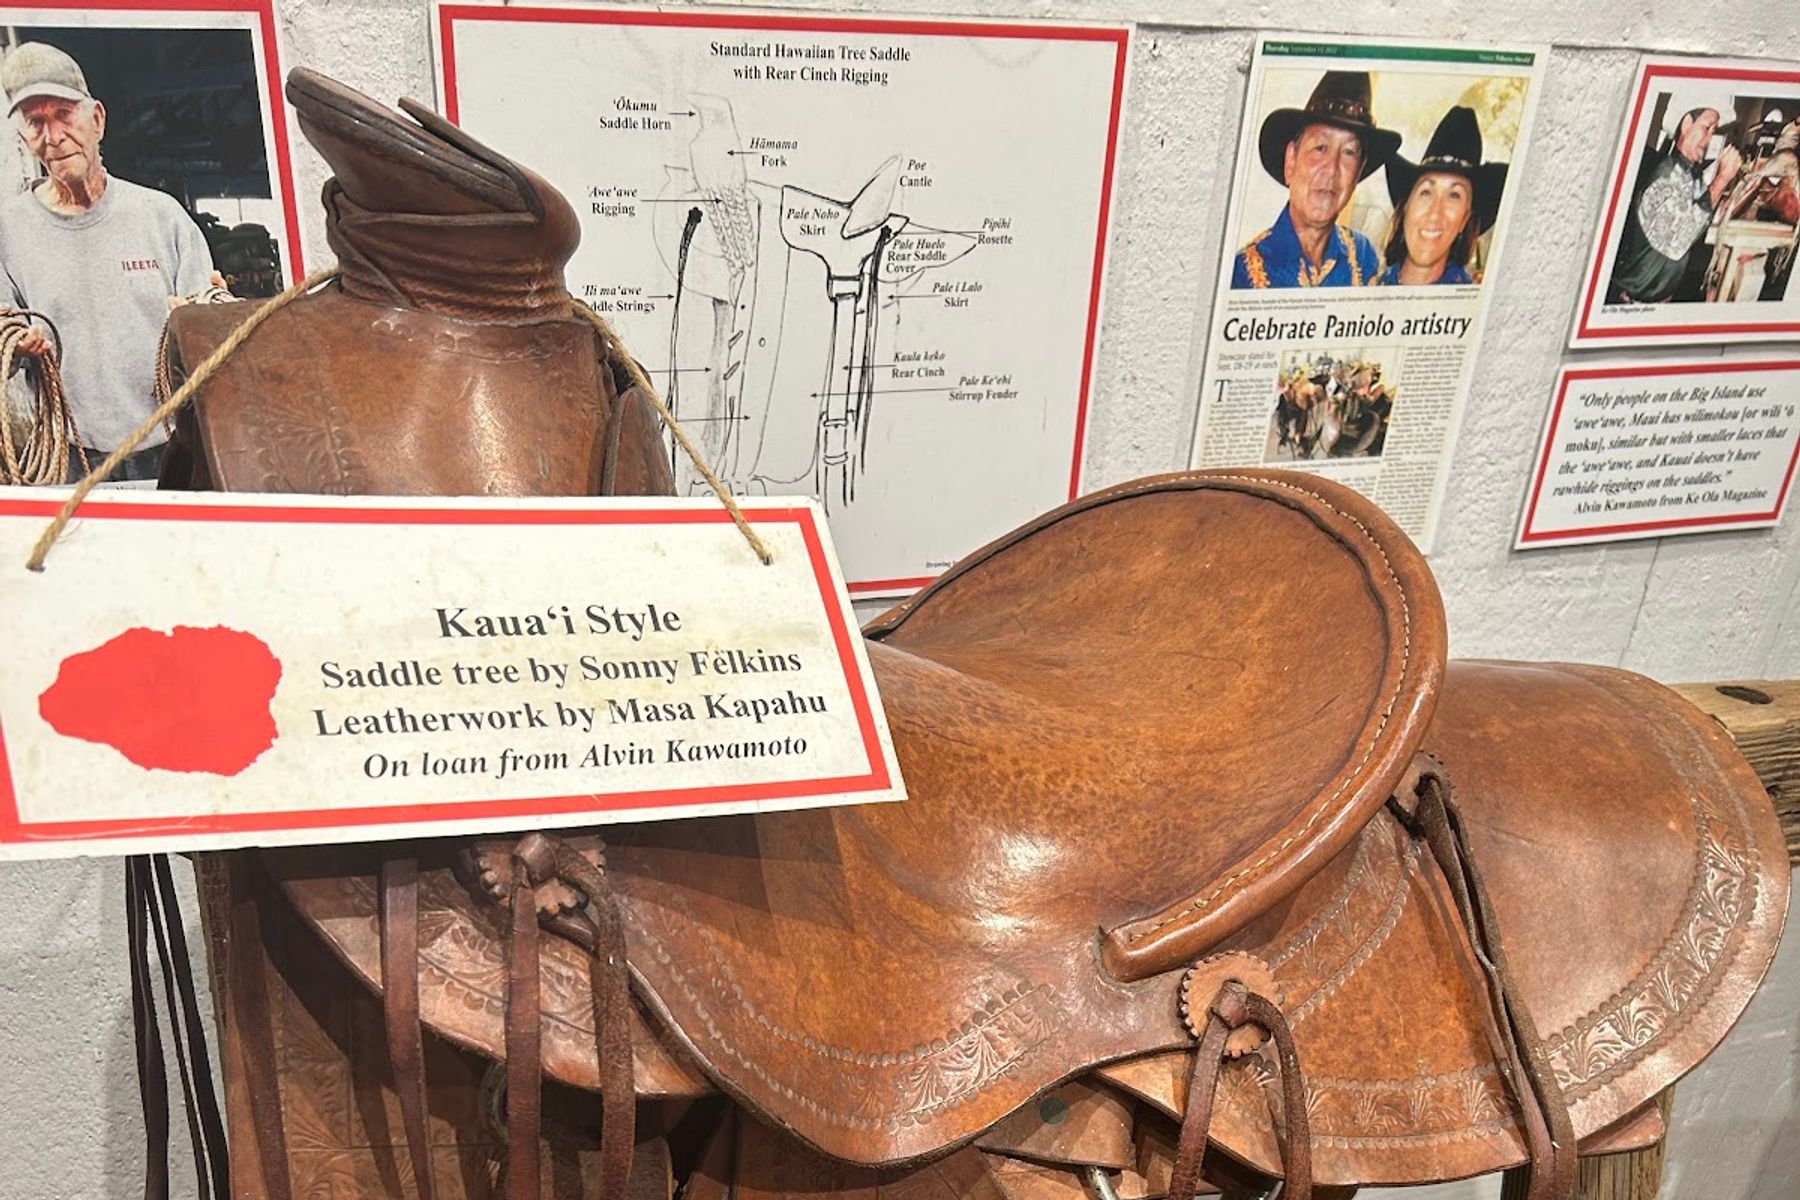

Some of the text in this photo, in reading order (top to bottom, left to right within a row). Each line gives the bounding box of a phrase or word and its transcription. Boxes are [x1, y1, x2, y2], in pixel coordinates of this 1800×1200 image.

[710, 42, 911, 61] Standard Hawaiian Tree Saddle
[733, 67, 889, 85] with Rear Cinch Rigging
[600, 116, 671, 130] Saddle Horn
[761, 155, 787, 167] Fork
[907, 160, 926, 171] Poe
[900, 175, 932, 187] Cantle
[592, 202, 635, 217] Rigging
[787, 208, 840, 219] Pale Noho
[800, 224, 825, 235] Skirt
[893, 239, 946, 250] Pale Huelo
[978, 234, 1013, 245] Rosette
[888, 250, 947, 261] Rear Saddle
[886, 262, 915, 273] Cover
[933, 282, 953, 293] Pale
[961, 282, 983, 293] Lalo
[616, 300, 655, 314] Strings
[944, 297, 969, 307] Skirt
[1223, 312, 1472, 342] Celebrate Paniolo artistry
[892, 367, 945, 378] Rear Cinch
[959, 376, 979, 386] Pale
[949, 388, 1019, 402] Stirrup Fender
[1611, 389, 1652, 410] people
[1652, 392, 1668, 404] on
[1668, 388, 1689, 402] the
[1689, 386, 1710, 404] Big
[1711, 384, 1748, 400] Island
[1747, 388, 1767, 398] use
[1628, 411, 1662, 427] Maui
[1661, 411, 1682, 425] has
[1761, 404, 1783, 418] wili
[1607, 433, 1648, 450] similar
[1649, 433, 1669, 447] but
[1670, 430, 1694, 445] with
[1694, 428, 1736, 443] smaller
[1735, 427, 1764, 441] laces
[1764, 425, 1788, 440] that
[1558, 461, 1578, 475] the
[1636, 454, 1660, 469] and
[1659, 451, 1695, 467] Kauai
[1734, 448, 1761, 461] have
[1552, 481, 1599, 497] rawhide
[1599, 478, 1644, 496] riggings
[1646, 478, 1661, 489] on
[1662, 474, 1681, 488] the
[1573, 488, 1768, 515] Alvin Kawamoto from Ke Ola Magazine
[435, 604, 682, 642] Kaua‘i Style
[320, 660, 443, 689] Saddle
[453, 660, 520, 686] tree
[530, 657, 569, 689] by
[580, 654, 680, 685] Sonny
[314, 691, 828, 737] Leatherwork by Masa Kapahu
[364, 736, 808, 780] On loan from Alvin Kawamoto
